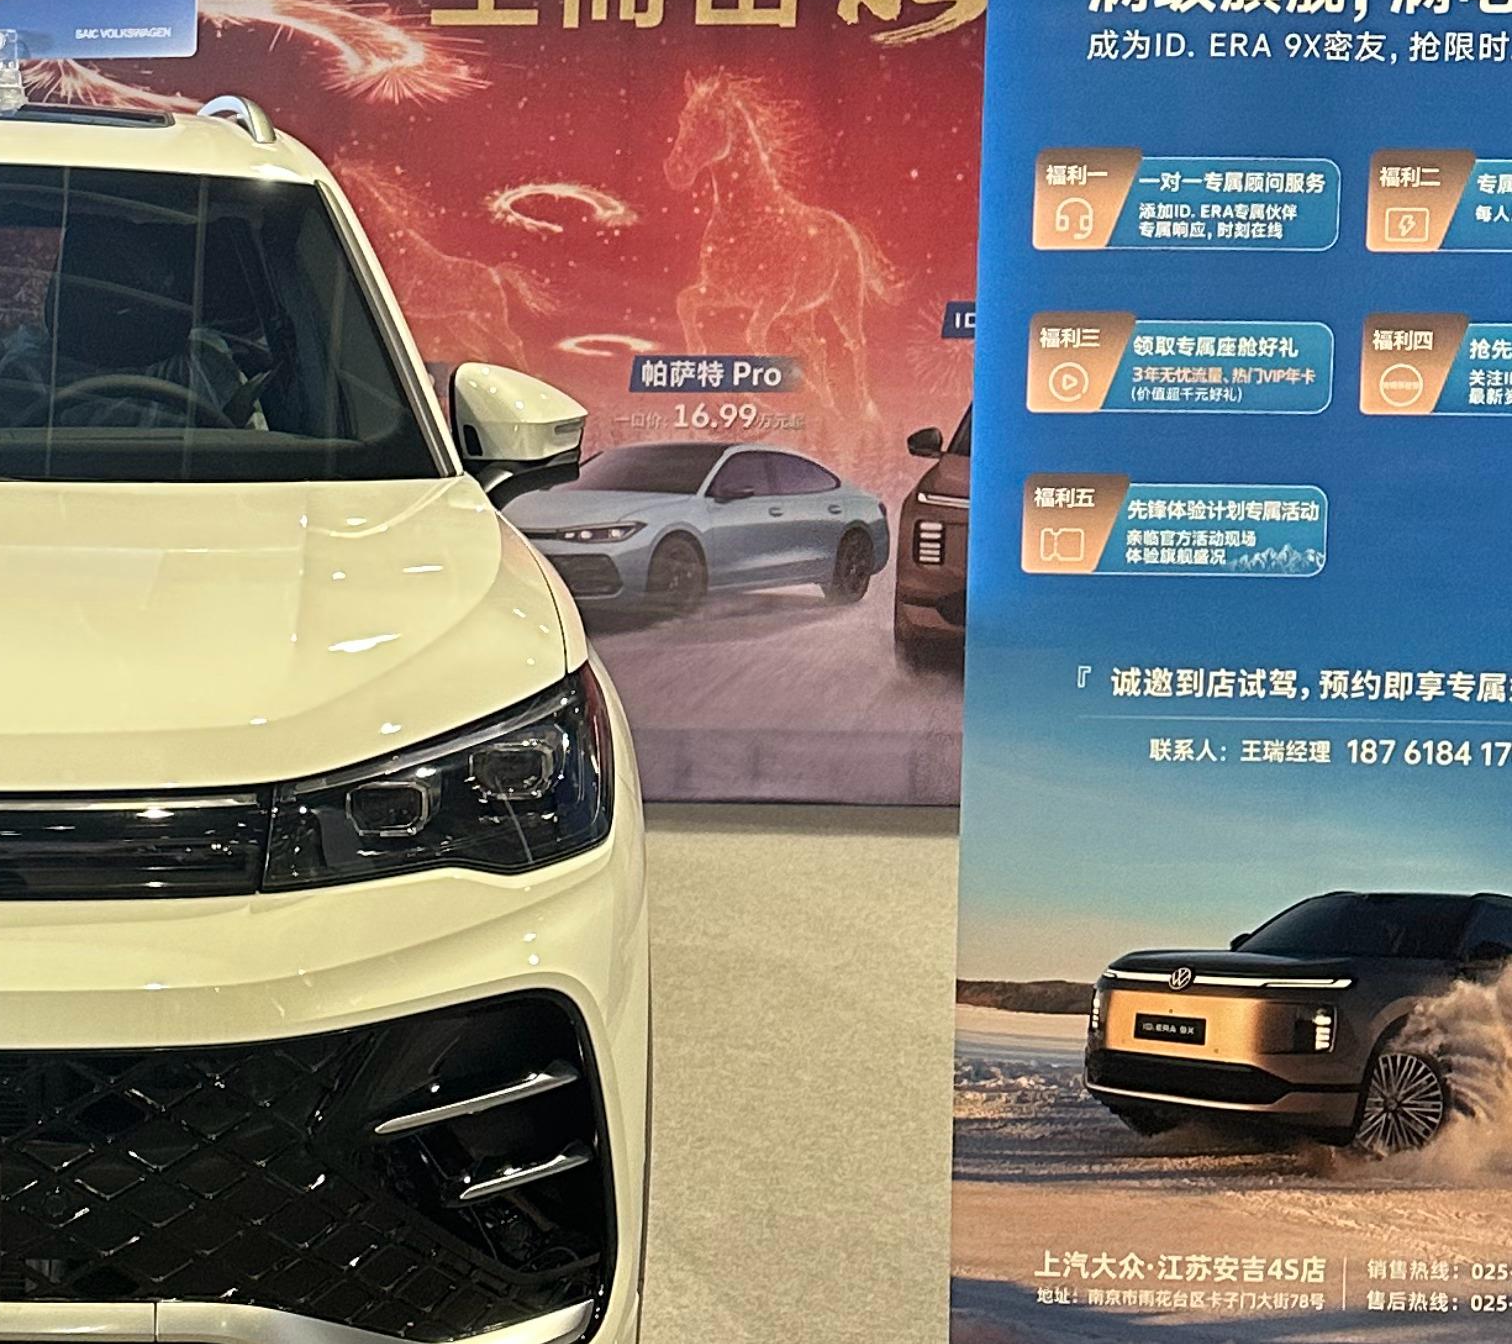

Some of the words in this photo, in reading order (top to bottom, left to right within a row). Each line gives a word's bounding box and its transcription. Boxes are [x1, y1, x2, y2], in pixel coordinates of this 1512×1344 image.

[1210, 32, 1271, 57] ERA
[1284, 29, 1512, 64] 9X密友，抢限时
[1046, 164, 1108, 186] 福利一
[1138, 171, 1326, 194] 一对一专属顾问服务
[1379, 166, 1441, 188] 福利二
[1475, 204, 1512, 223] 每人
[1039, 327, 1101, 349] 福利三
[1132, 335, 1300, 358] 领取专属座舱好礼
[1372, 329, 1434, 351] 福利四
[641, 359, 724, 388] 帕萨特
[733, 361, 782, 387] Pro
[1034, 486, 1096, 508] 福利五
[1127, 499, 1320, 522] 先锋体验计划专属活动
[1126, 529, 1257, 548] 亲临官方活动现场
[1125, 547, 1227, 566] 体验旗舰盛况
[1110, 667, 1512, 703] 诚邀到店试驾，预约即享专属
[1347, 739, 1396, 764] 187
[1404, 739, 1472, 766] 6184
